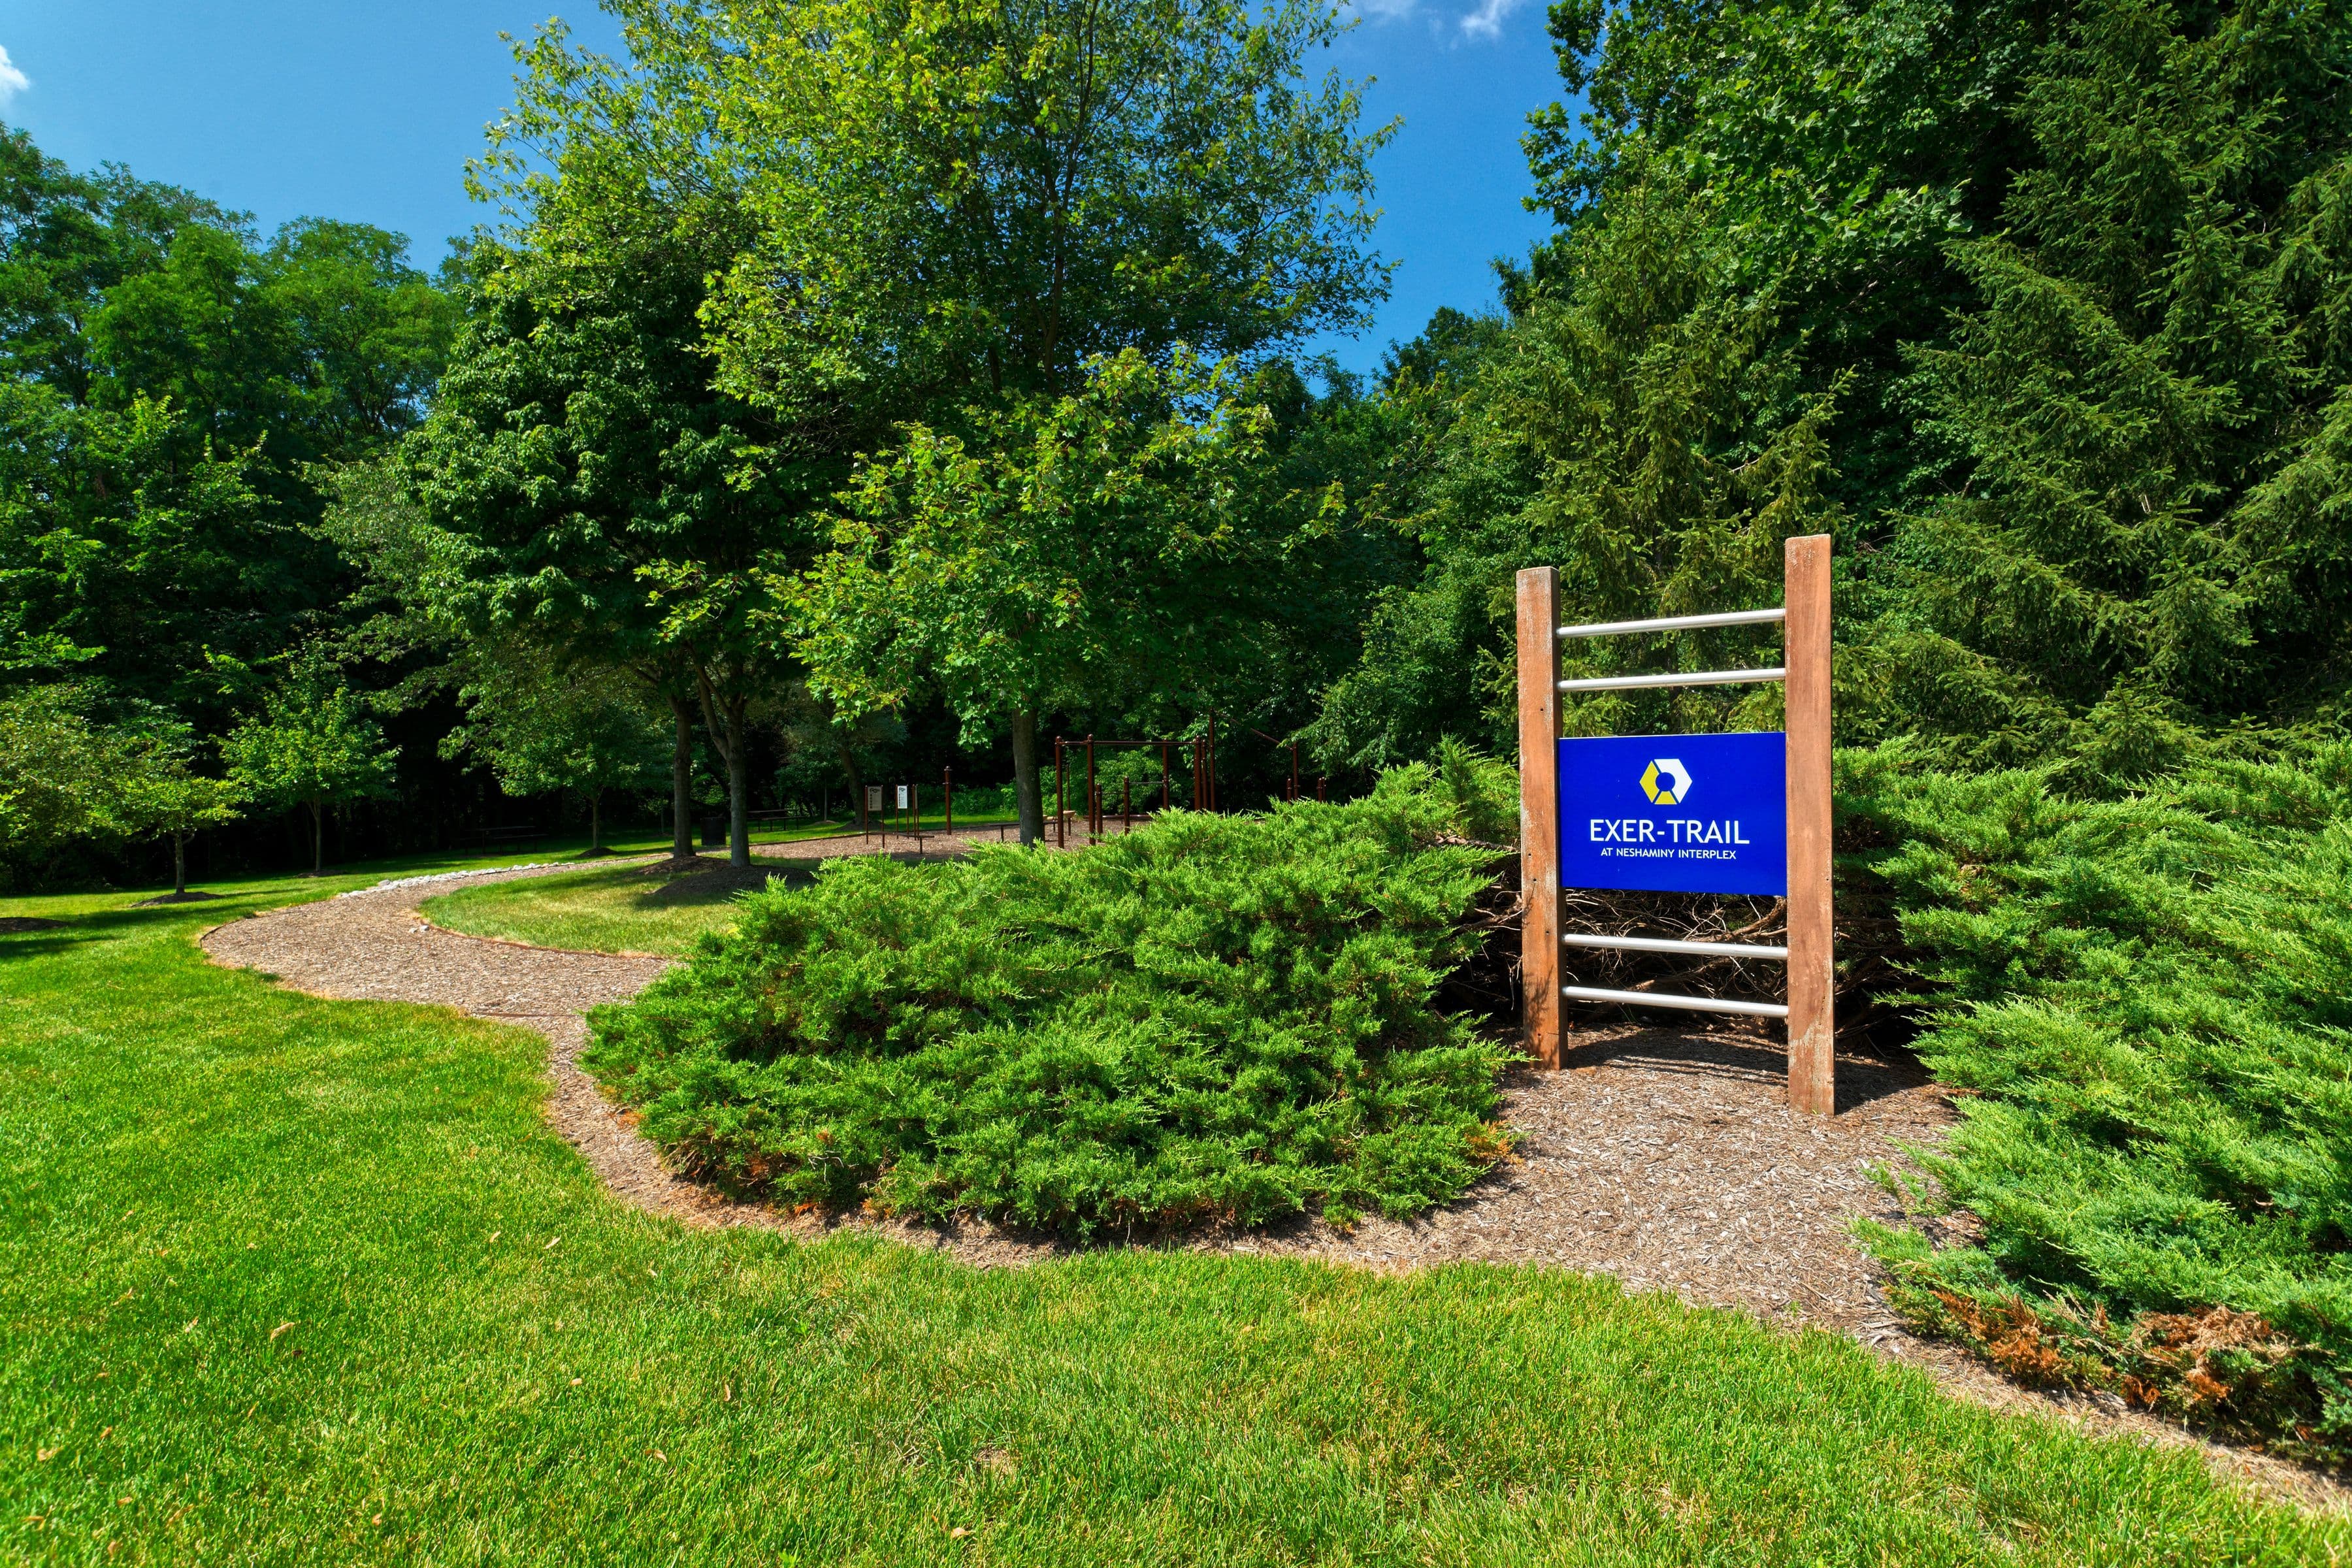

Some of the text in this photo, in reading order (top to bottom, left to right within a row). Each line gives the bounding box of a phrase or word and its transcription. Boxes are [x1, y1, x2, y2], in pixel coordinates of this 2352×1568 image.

[1590, 819, 1750, 844] EXER-TRAIL
[1601, 847, 1737, 860] AT NESHAMINY INTERPLEX
